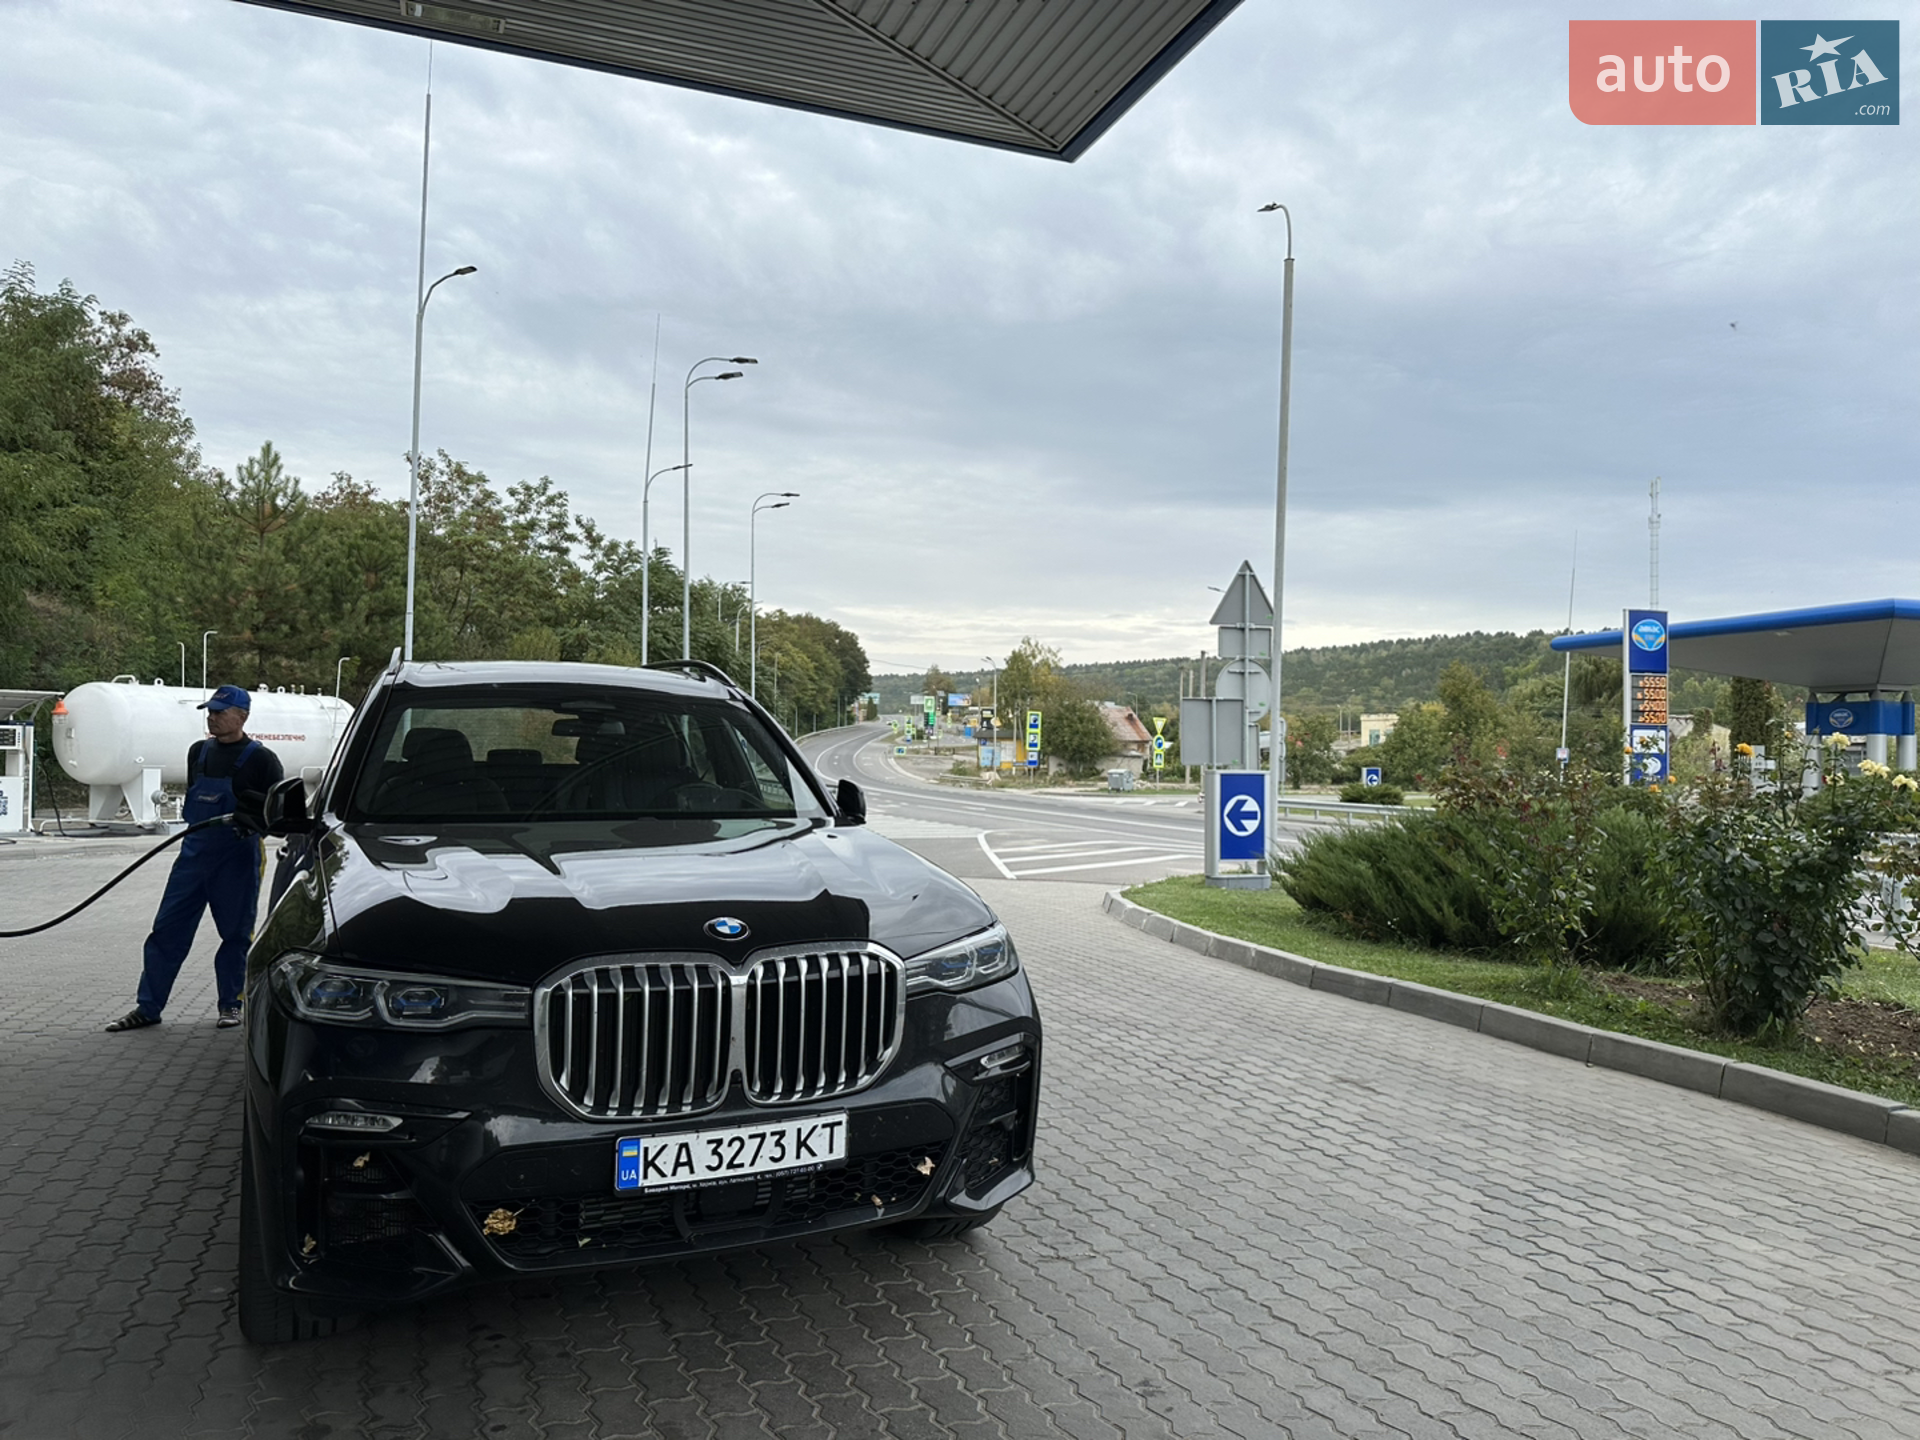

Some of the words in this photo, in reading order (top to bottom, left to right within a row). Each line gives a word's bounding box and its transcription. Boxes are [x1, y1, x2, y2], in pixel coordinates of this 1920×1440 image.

[642, 1142, 696, 1180] KA
[705, 1129, 787, 1172] 3273
[795, 1121, 843, 1159] KT
[621, 1169, 637, 1182] UA
